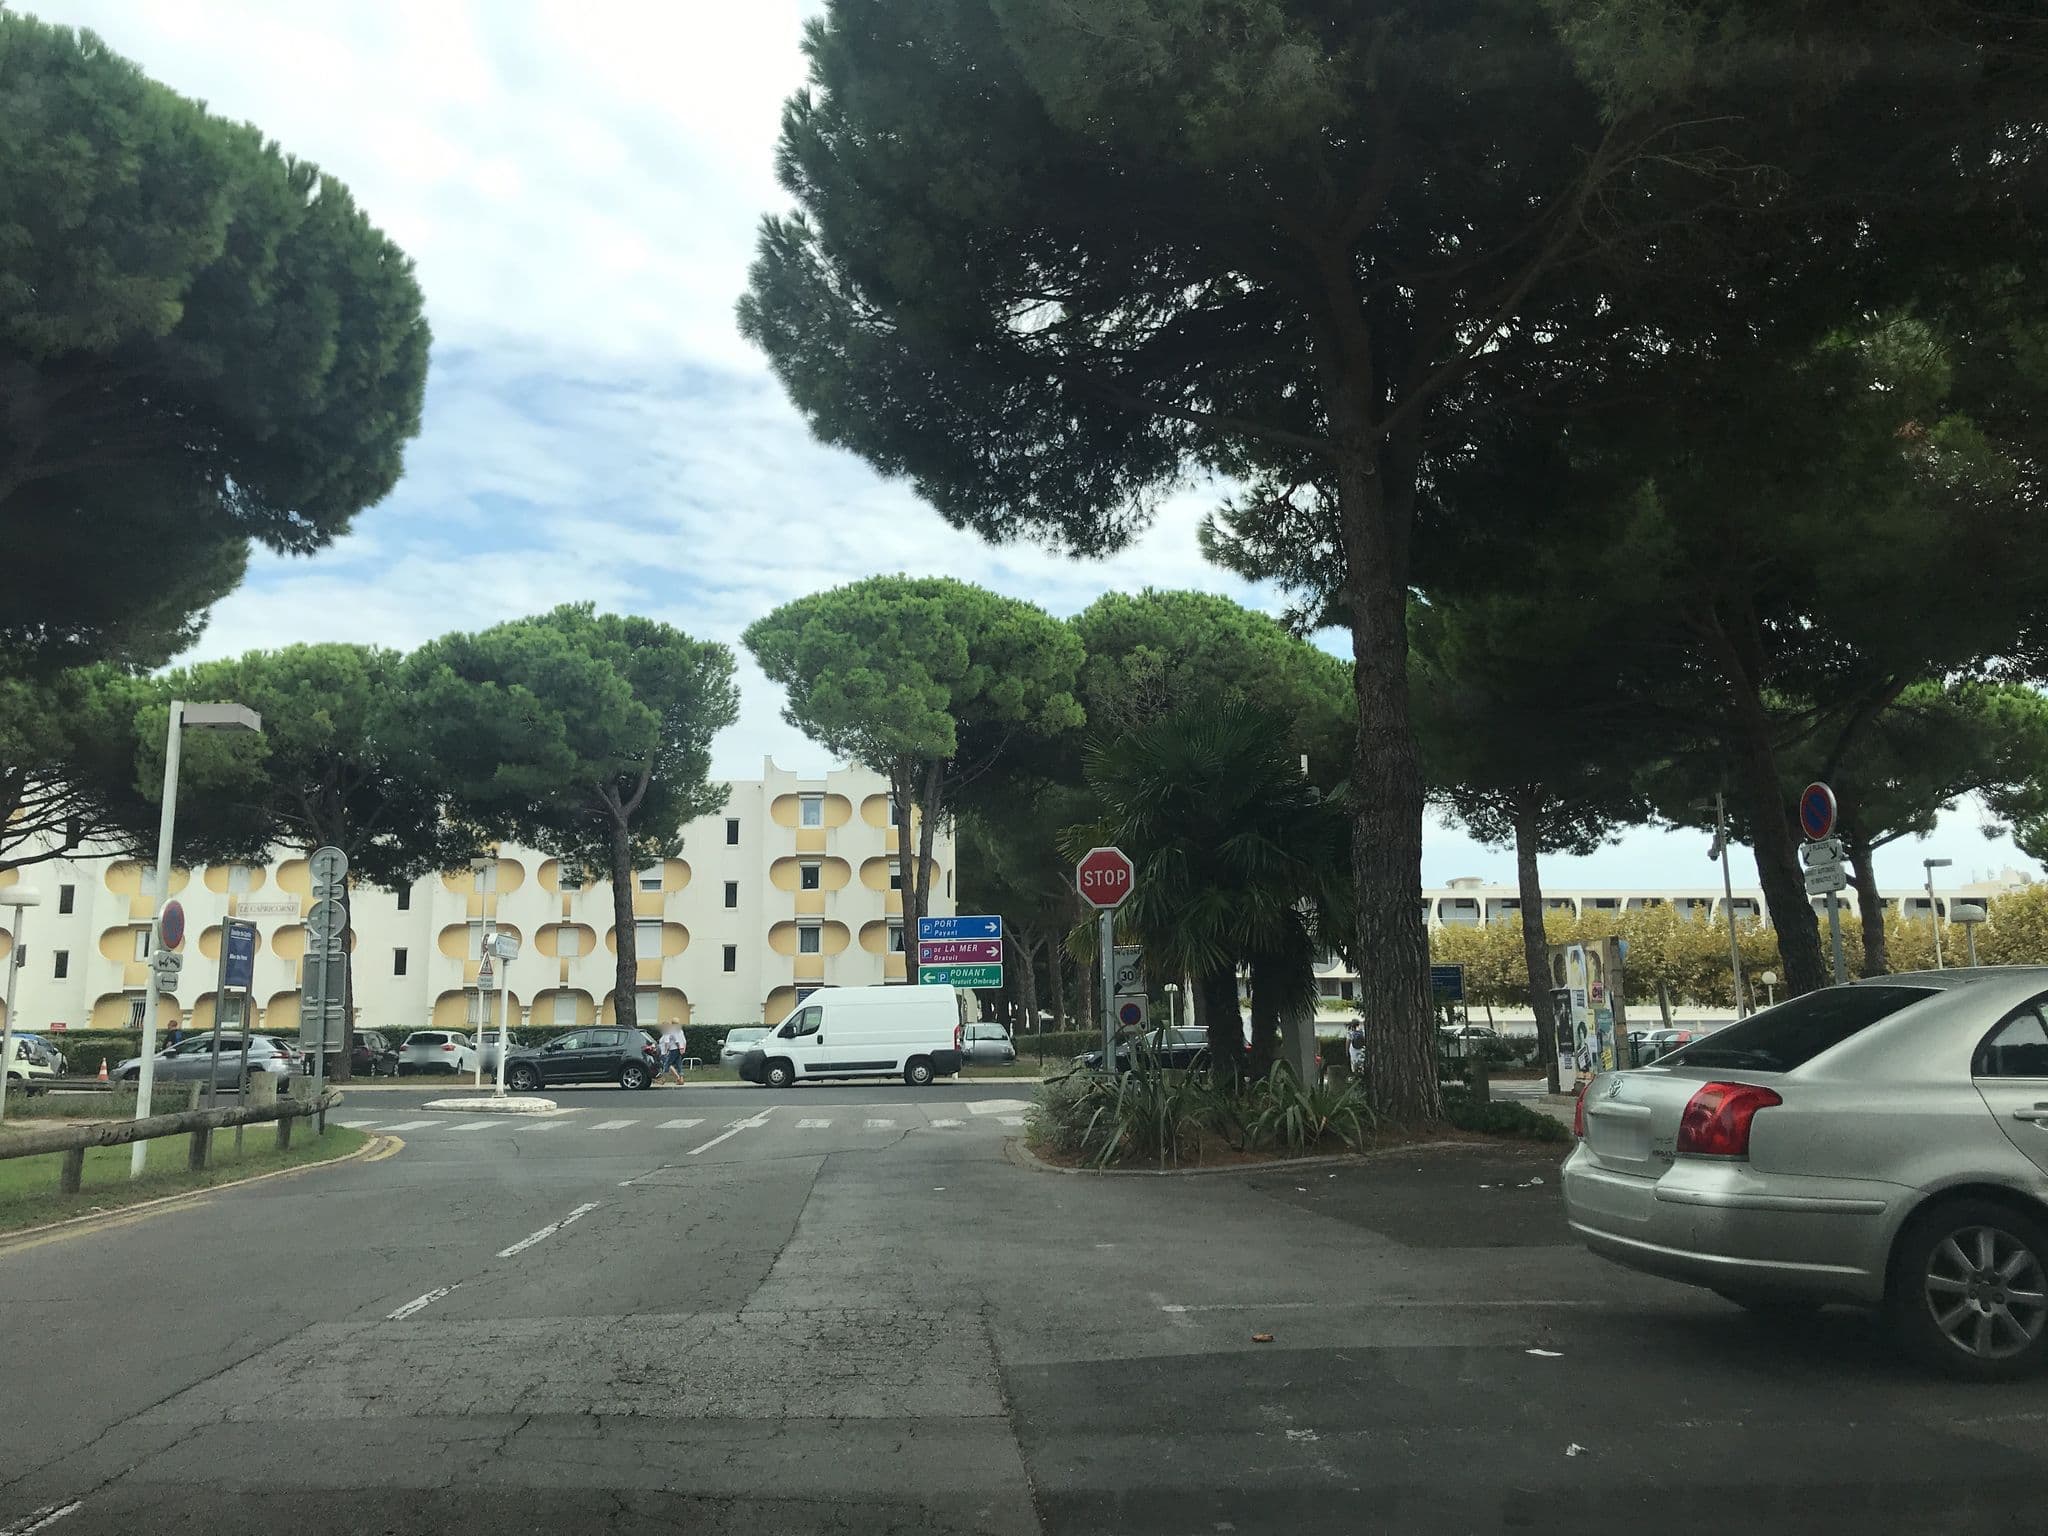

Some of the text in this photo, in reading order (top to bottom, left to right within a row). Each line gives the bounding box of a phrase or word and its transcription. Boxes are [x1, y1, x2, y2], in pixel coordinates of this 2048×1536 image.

[1084, 869, 1126, 887] STOP
[934, 919, 958, 928] PORT
[934, 929, 958, 937] Payant
[944, 944, 956, 953] LA
[960, 944, 978, 952] MER
[950, 968, 986, 977] PONANT
[1121, 970, 1134, 981] 30
